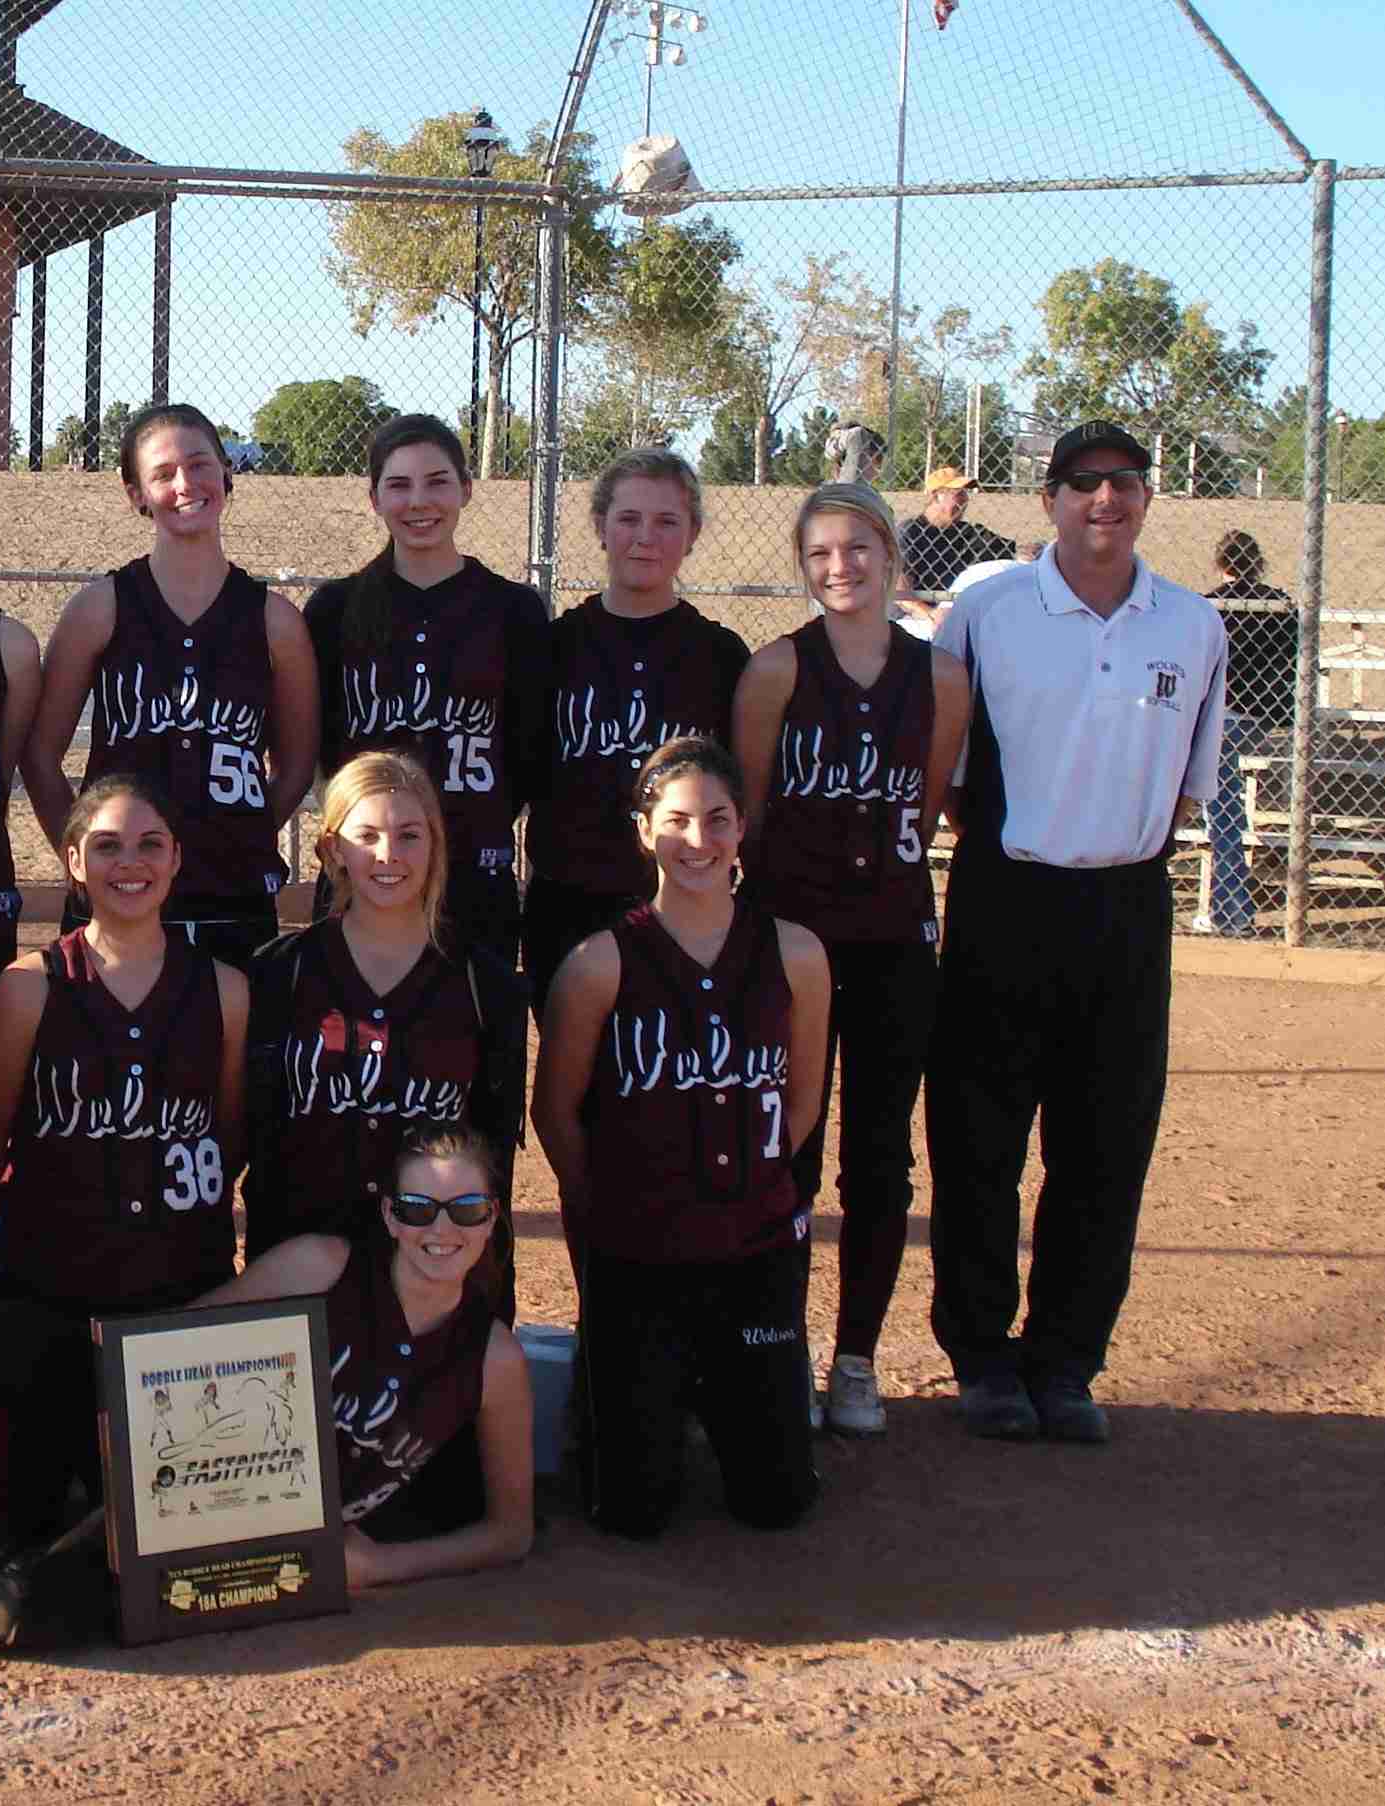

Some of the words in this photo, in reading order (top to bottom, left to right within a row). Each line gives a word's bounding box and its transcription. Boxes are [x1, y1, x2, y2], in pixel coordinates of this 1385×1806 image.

[207, 742, 266, 809] 56
[443, 733, 496, 793] 15
[895, 807, 923, 864] 5
[760, 1089, 783, 1160] 7
[162, 1137, 225, 1212] 38
[218, 1583, 279, 1608] CHAMPIONS
